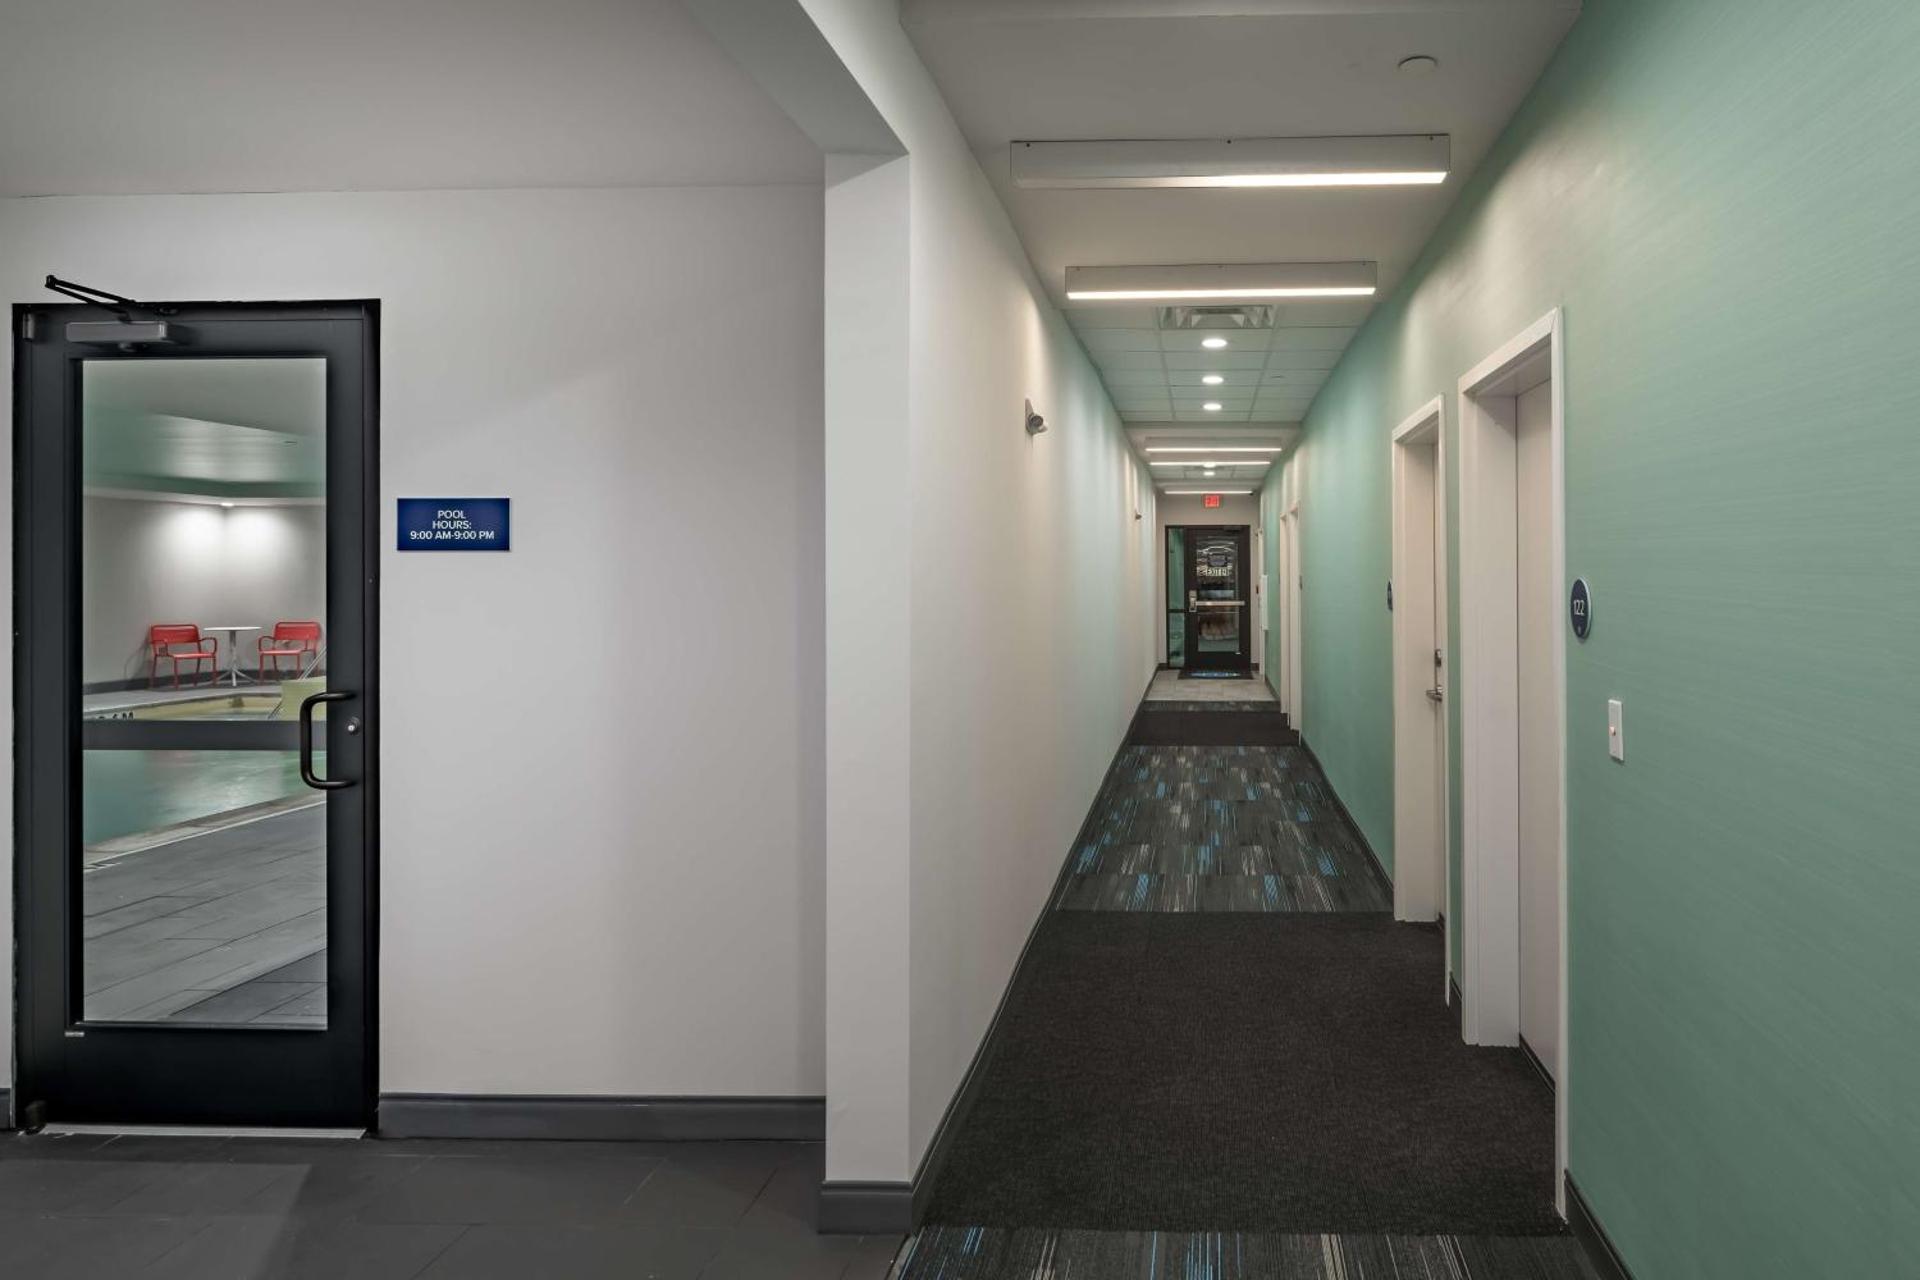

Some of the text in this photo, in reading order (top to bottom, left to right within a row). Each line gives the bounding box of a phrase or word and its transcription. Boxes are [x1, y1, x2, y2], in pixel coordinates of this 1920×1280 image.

[437, 510, 466, 519] POOL
[432, 520, 472, 529] HOURS:
[410, 531, 495, 540] 9:00 AM-9:00 PM
[1573, 599, 1585, 615] 122
